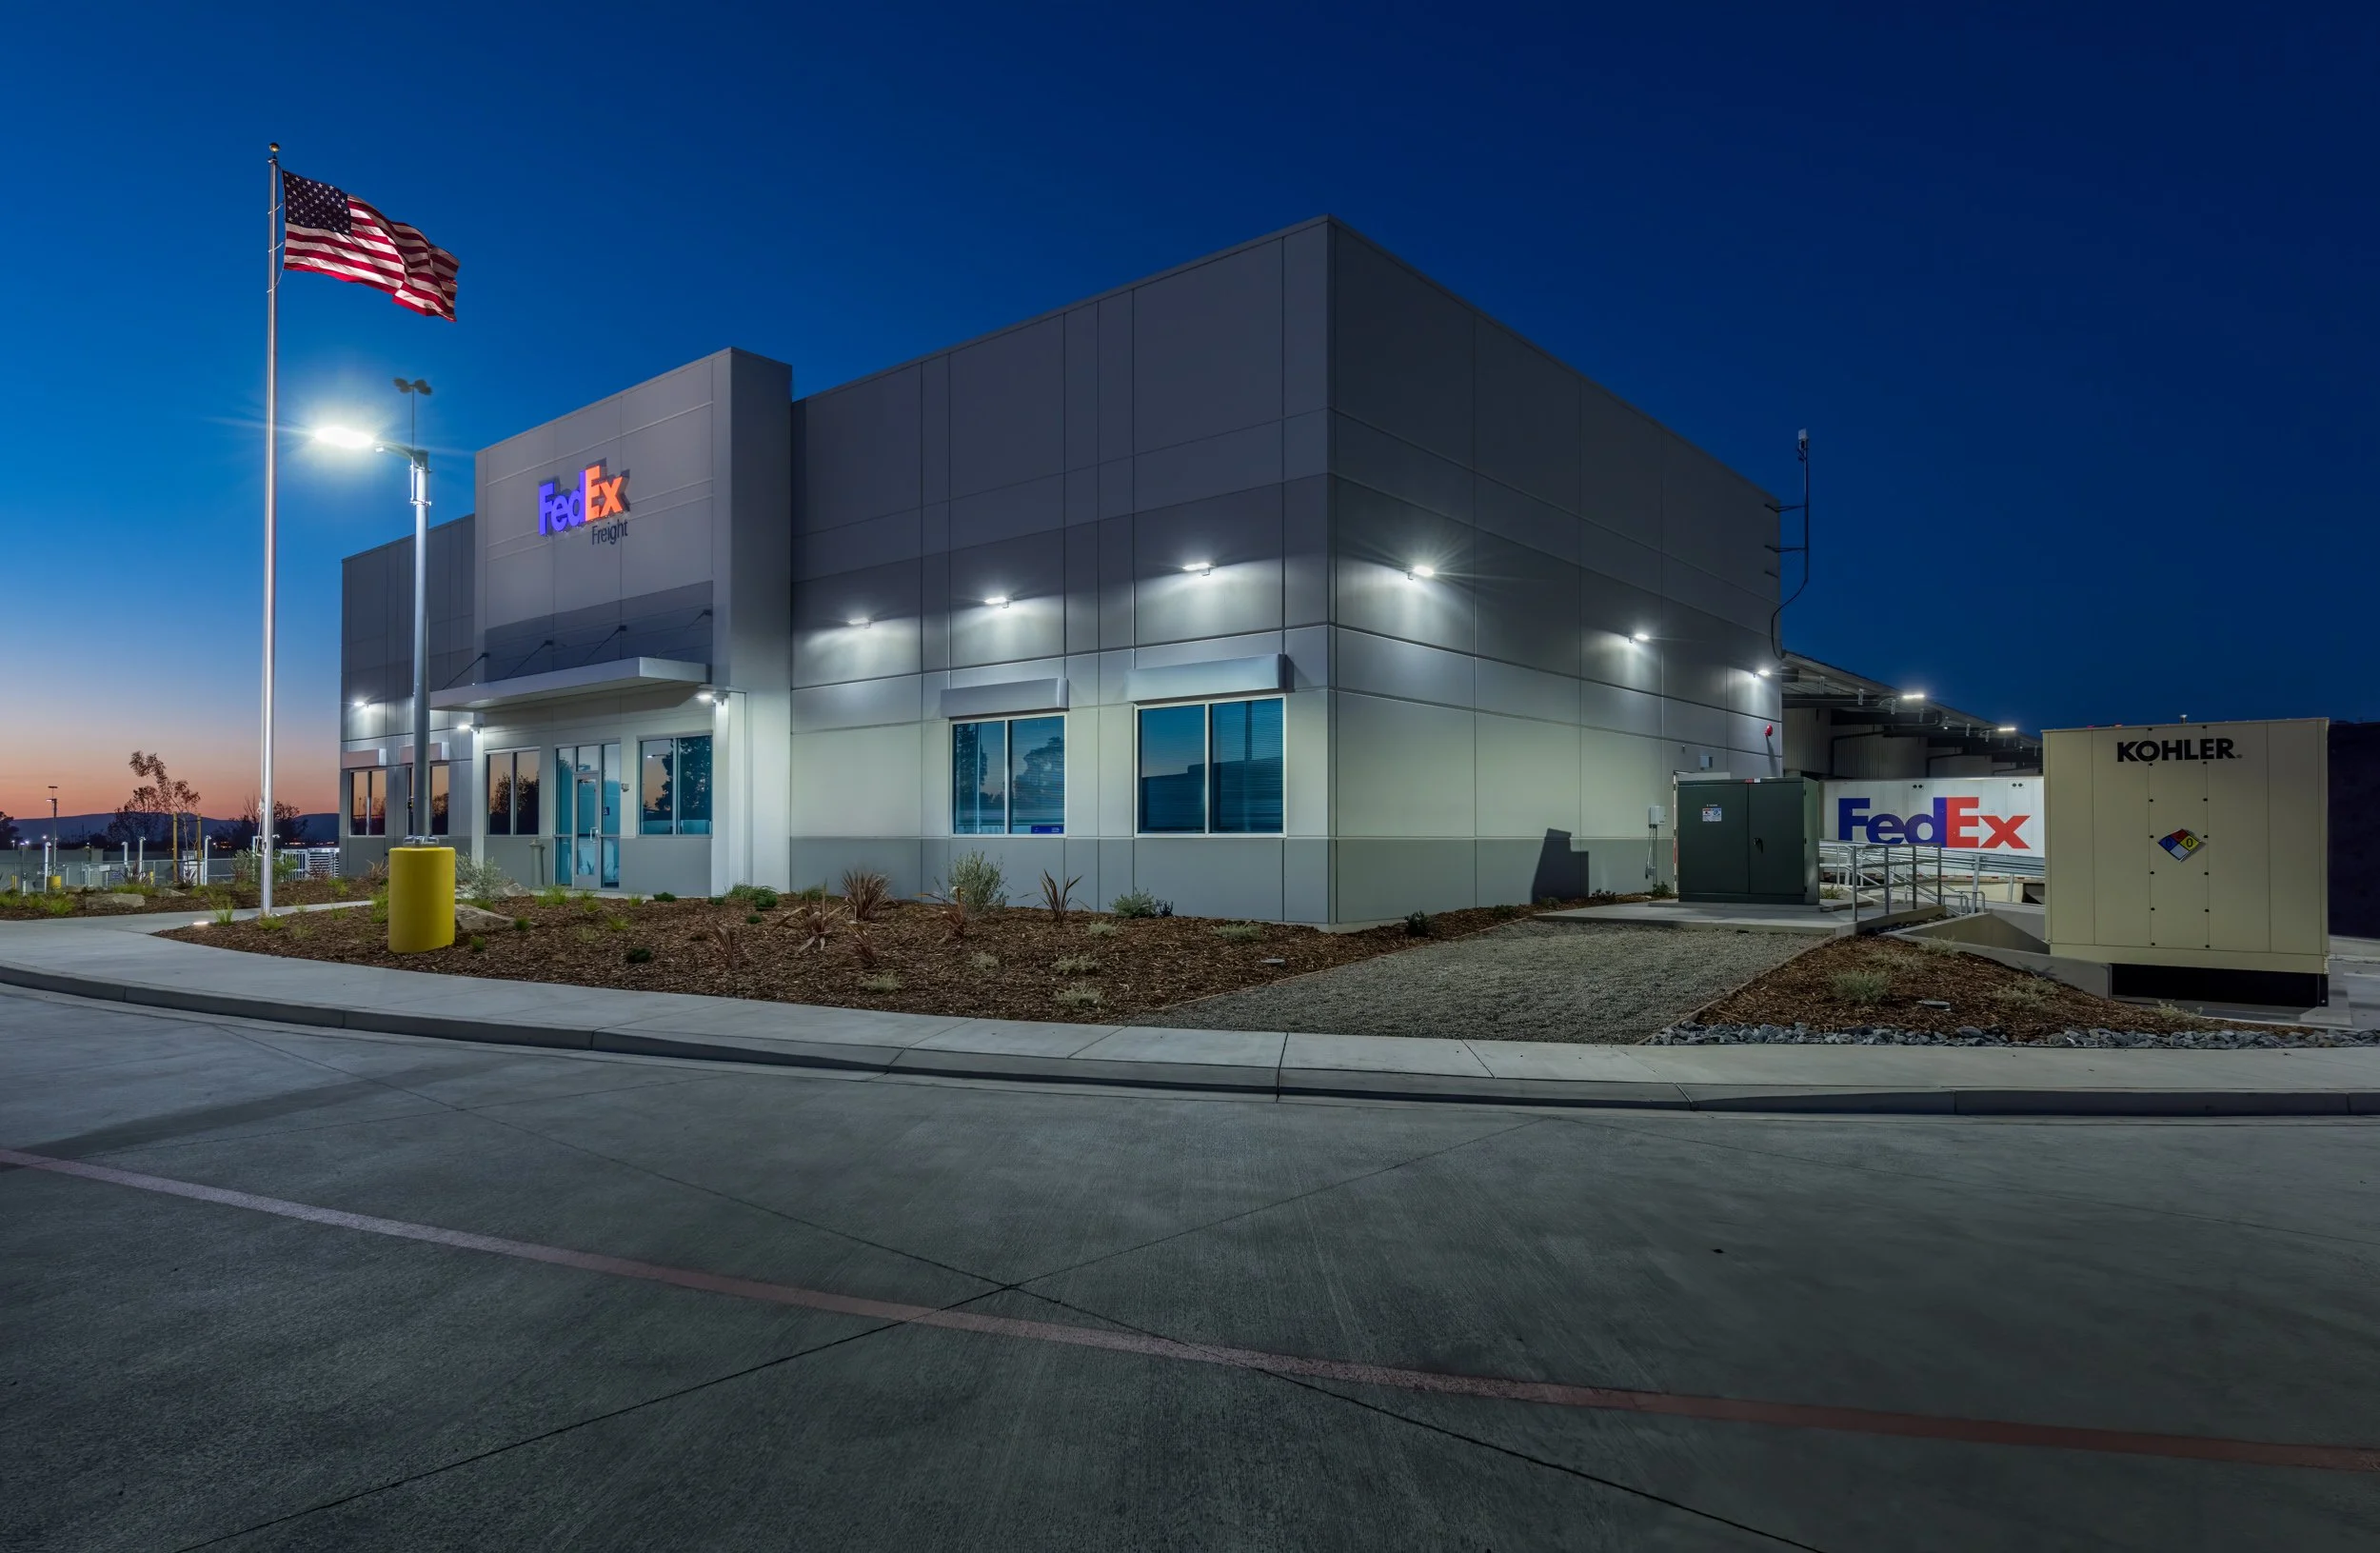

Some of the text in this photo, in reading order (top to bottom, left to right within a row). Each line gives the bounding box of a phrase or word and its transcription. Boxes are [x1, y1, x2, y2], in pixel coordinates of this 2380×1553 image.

[539, 465, 623, 536] FedEx
[591, 520, 628, 545] Freight
[2117, 738, 2236, 762] KOHLER
[1838, 797, 2031, 848] FedEx
[2187, 838, 2193, 847] 0
